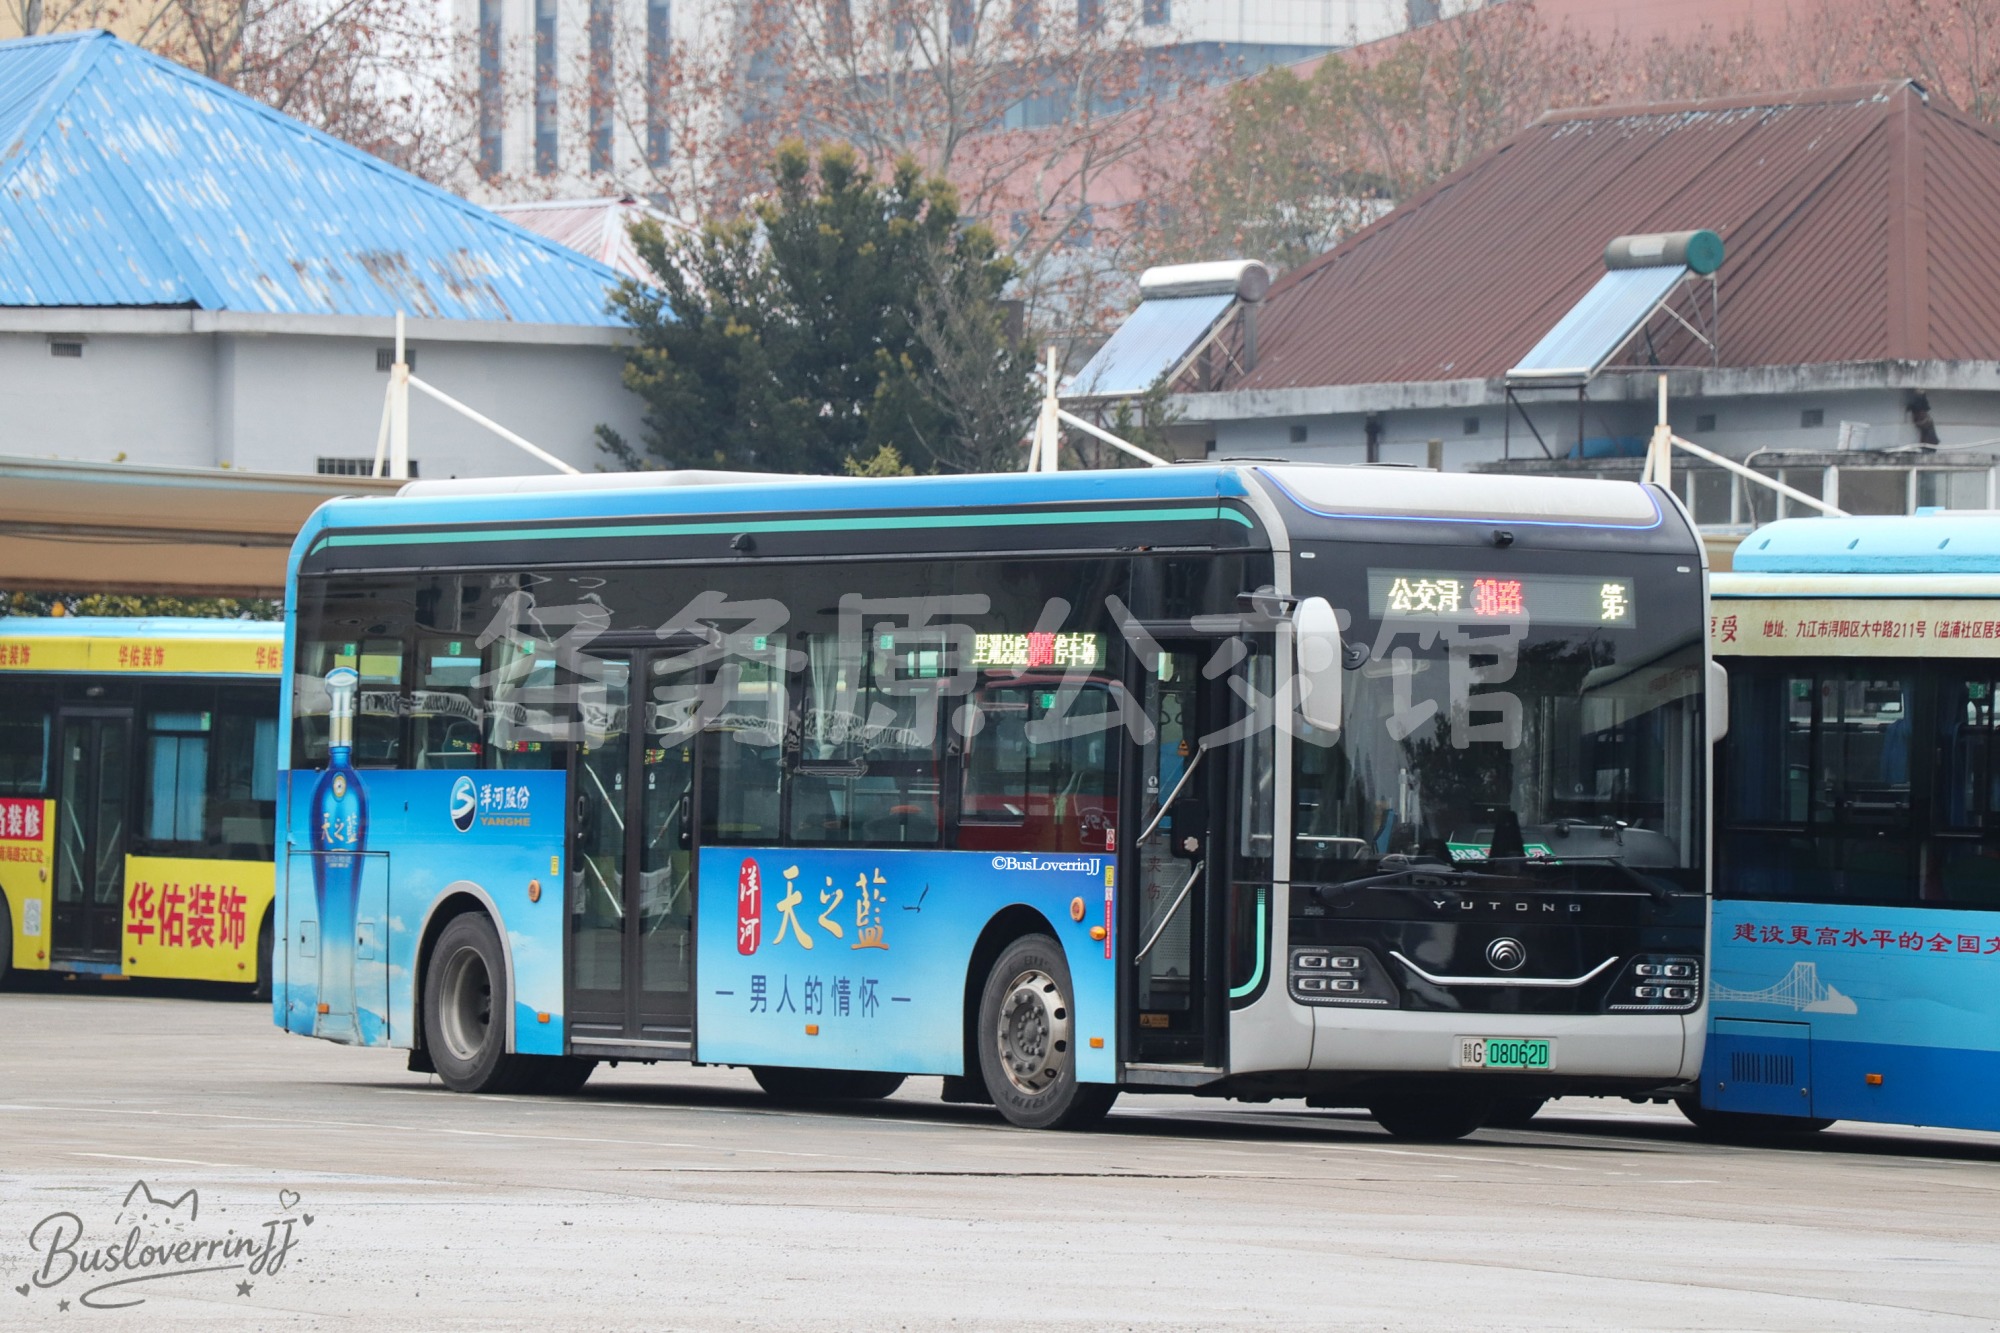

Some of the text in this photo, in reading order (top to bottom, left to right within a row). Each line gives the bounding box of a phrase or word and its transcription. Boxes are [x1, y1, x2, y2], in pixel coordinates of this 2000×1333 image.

[1600, 583, 1629, 620] 第
[118, 645, 165, 667] 华佑装饰
[255, 646, 284, 669] 华佑
[480, 784, 530, 813] 洋河股份
[480, 817, 531, 827] YANGHE
[126, 881, 248, 950] 华佑装饰
[740, 865, 759, 952] 洋河
[1433, 899, 1582, 913] YUTONG
